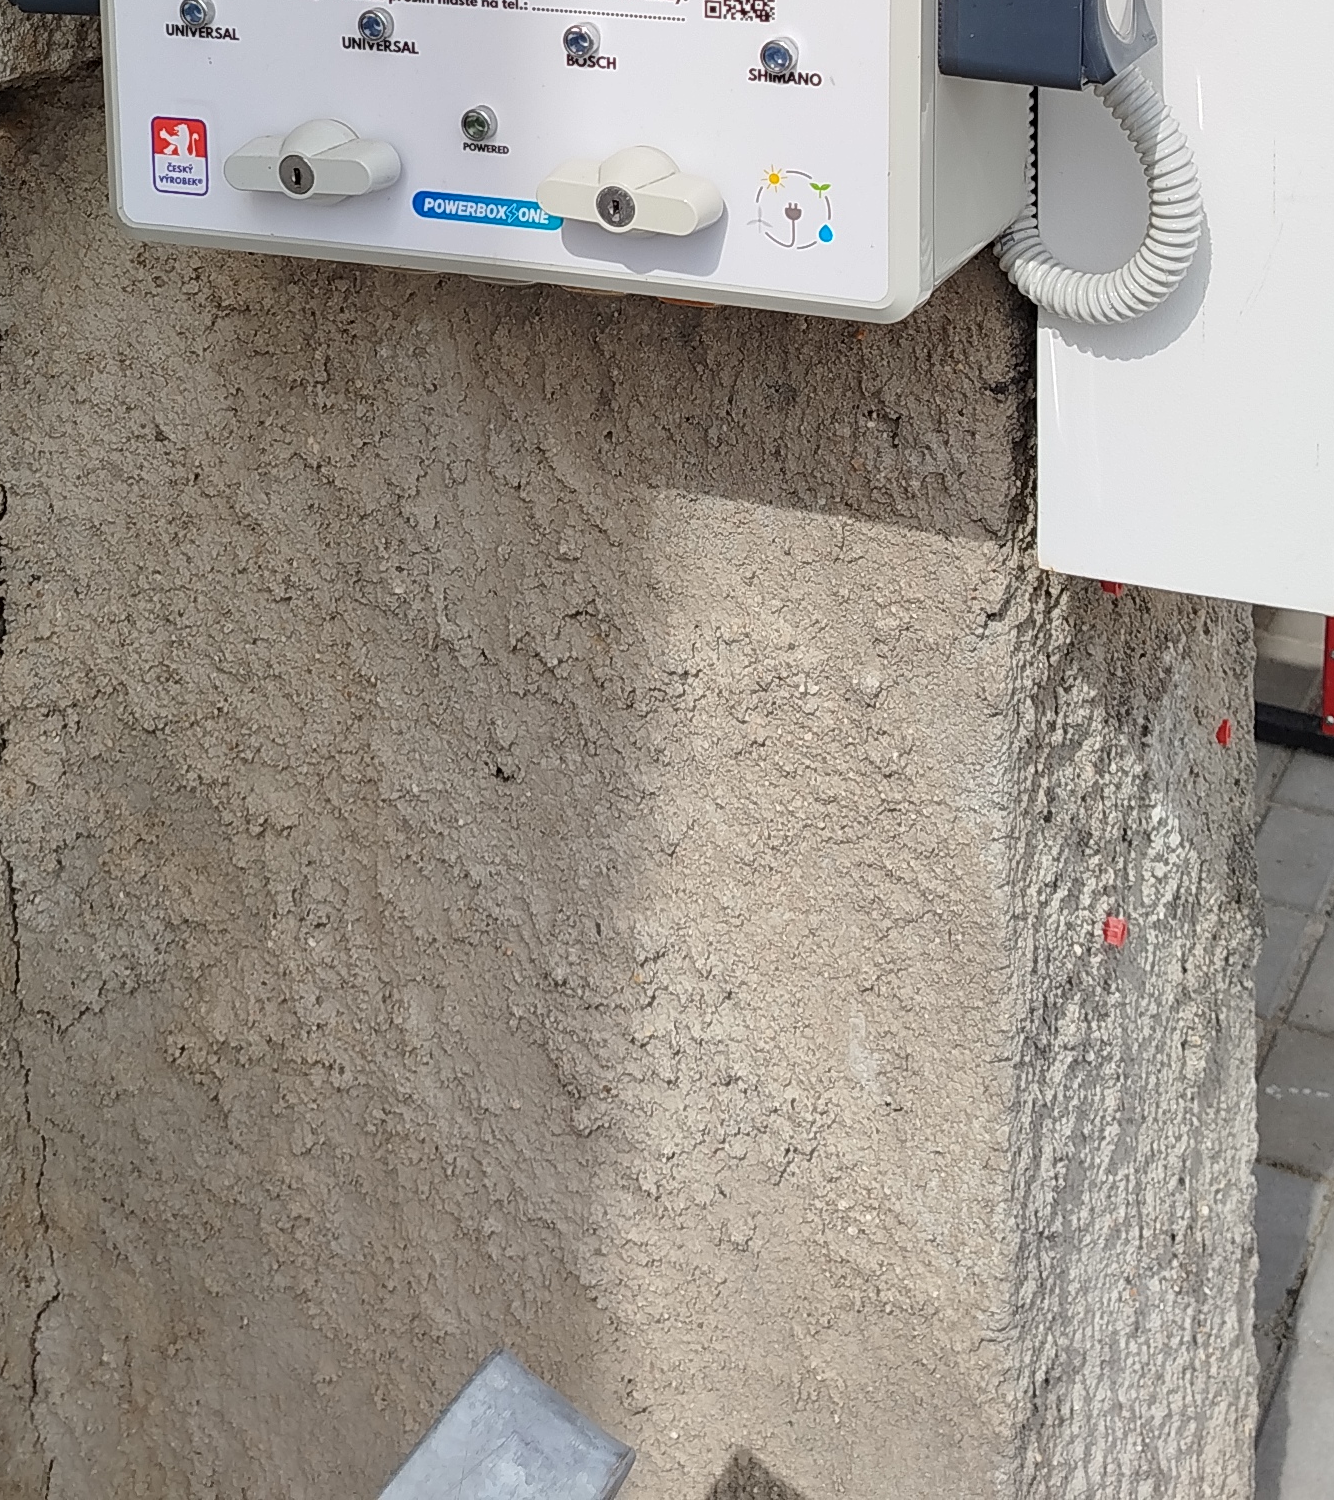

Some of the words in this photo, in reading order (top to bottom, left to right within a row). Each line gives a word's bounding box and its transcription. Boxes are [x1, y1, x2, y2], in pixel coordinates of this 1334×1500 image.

[165, 23, 240, 41] UNIVERSAL
[341, 36, 419, 55] UNIVERSAL
[566, 54, 617, 70] BOSCH
[748, 67, 822, 87] SHIMANO
[463, 142, 510, 155] POWERED
[167, 161, 193, 174] ČESKÝ
[424, 198, 508, 220] POWERBOX
